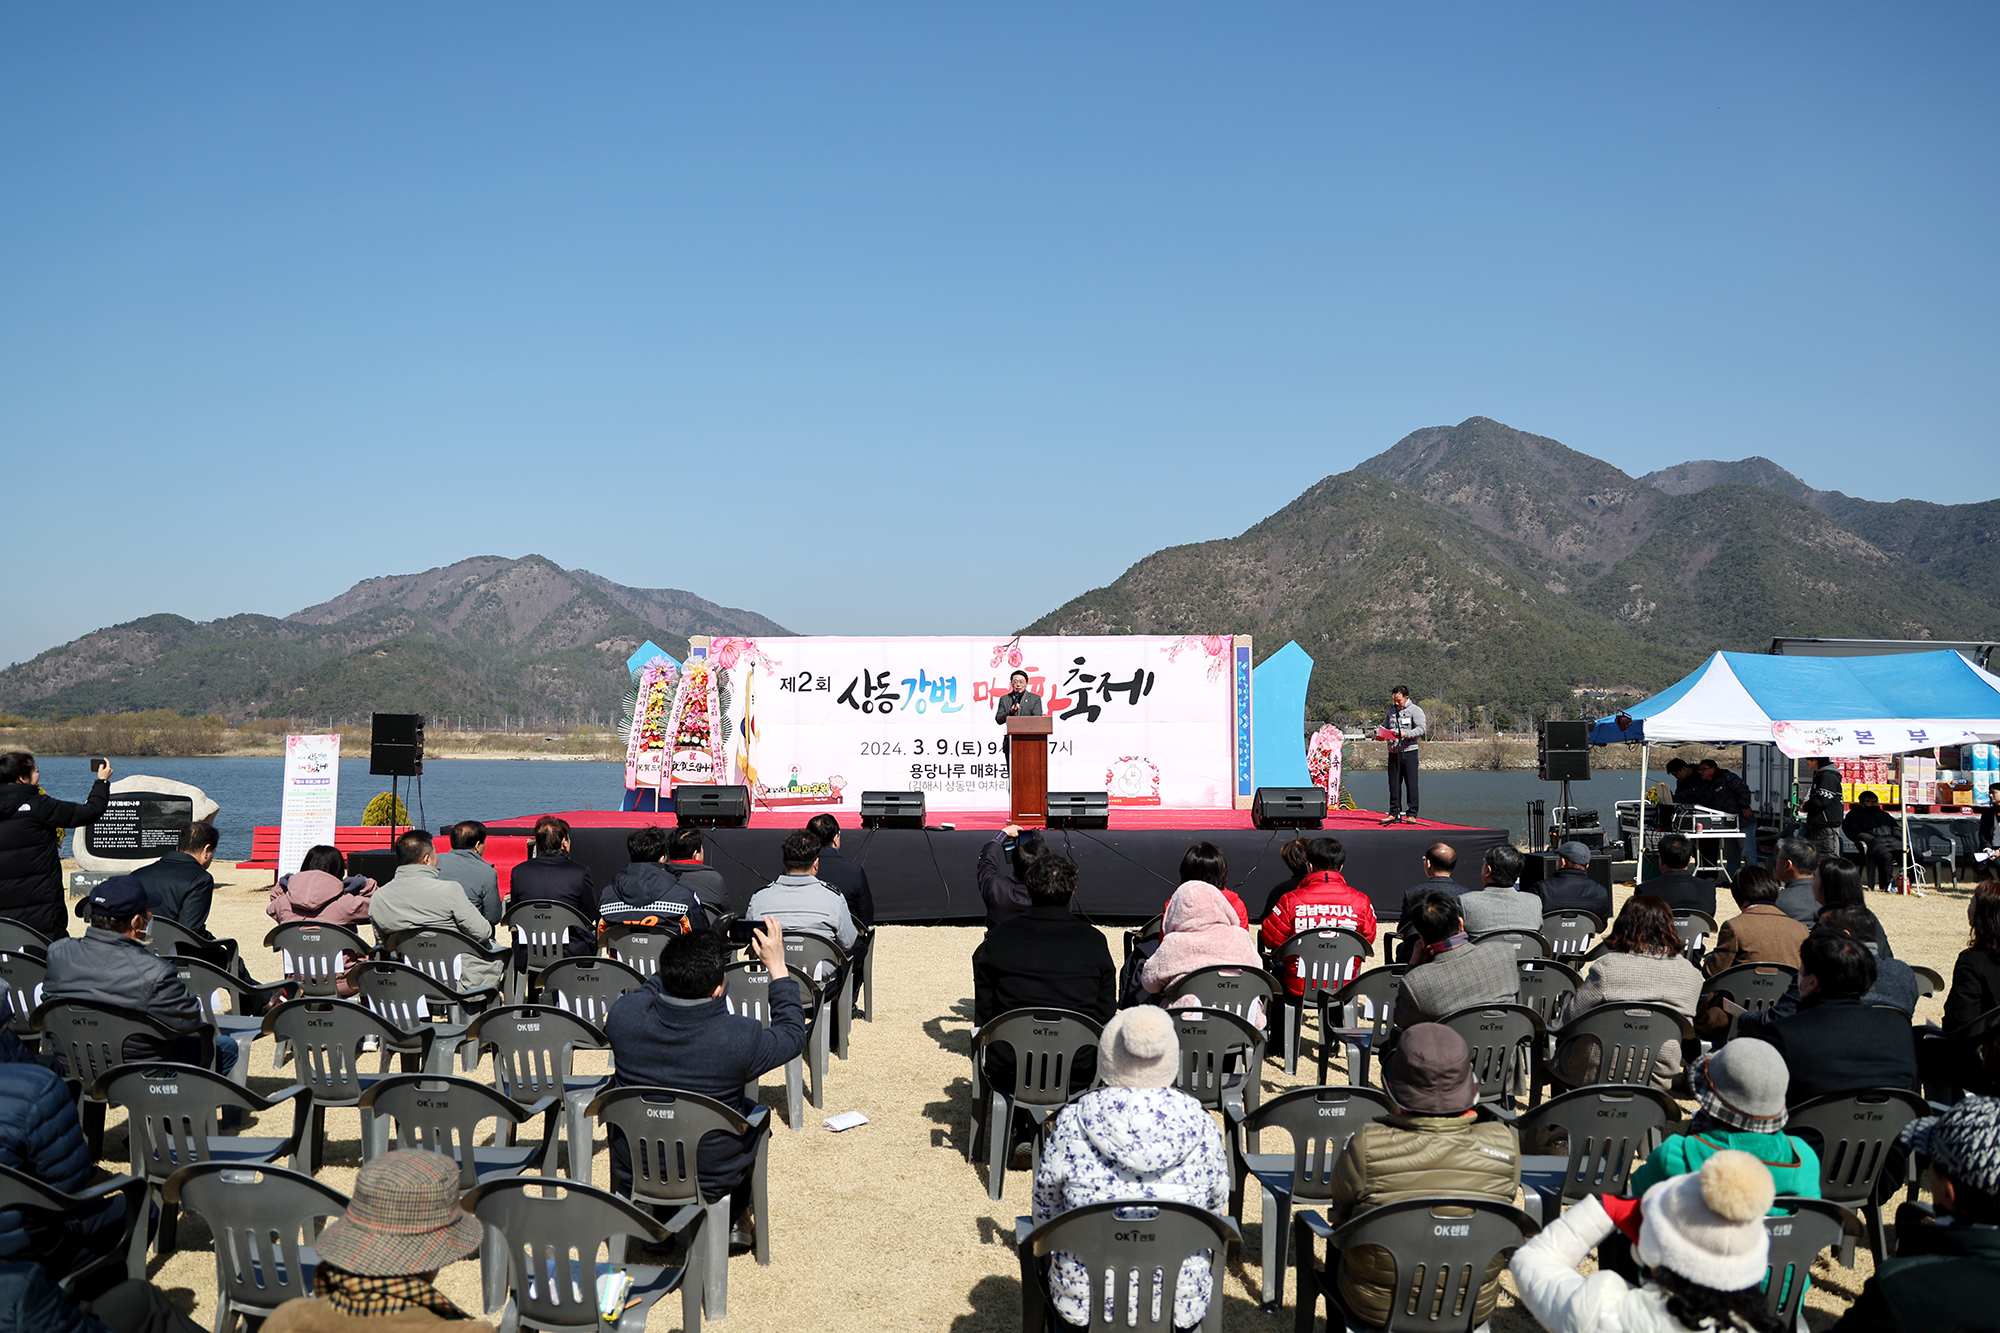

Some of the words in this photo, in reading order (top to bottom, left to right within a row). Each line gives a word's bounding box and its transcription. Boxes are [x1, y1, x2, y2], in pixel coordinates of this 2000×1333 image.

[779, 671, 831, 693] 제2회
[837, 668, 901, 715] 상동
[900, 668, 965, 715] 강변
[1059, 656, 1155, 723] 축제
[860, 741, 907, 756] 2024.
[913, 738, 930, 756] 3.
[909, 763, 966, 780] 용당나루
[790, 782, 829, 796] 매화공원
[908, 780, 943, 793] (김해시
[944, 780, 976, 793] 상동면
[647, 1109, 674, 1119] OK렌탈
[1319, 1107, 1346, 1117] OK렌탈
[1434, 1225, 1470, 1236] OK렌탈
